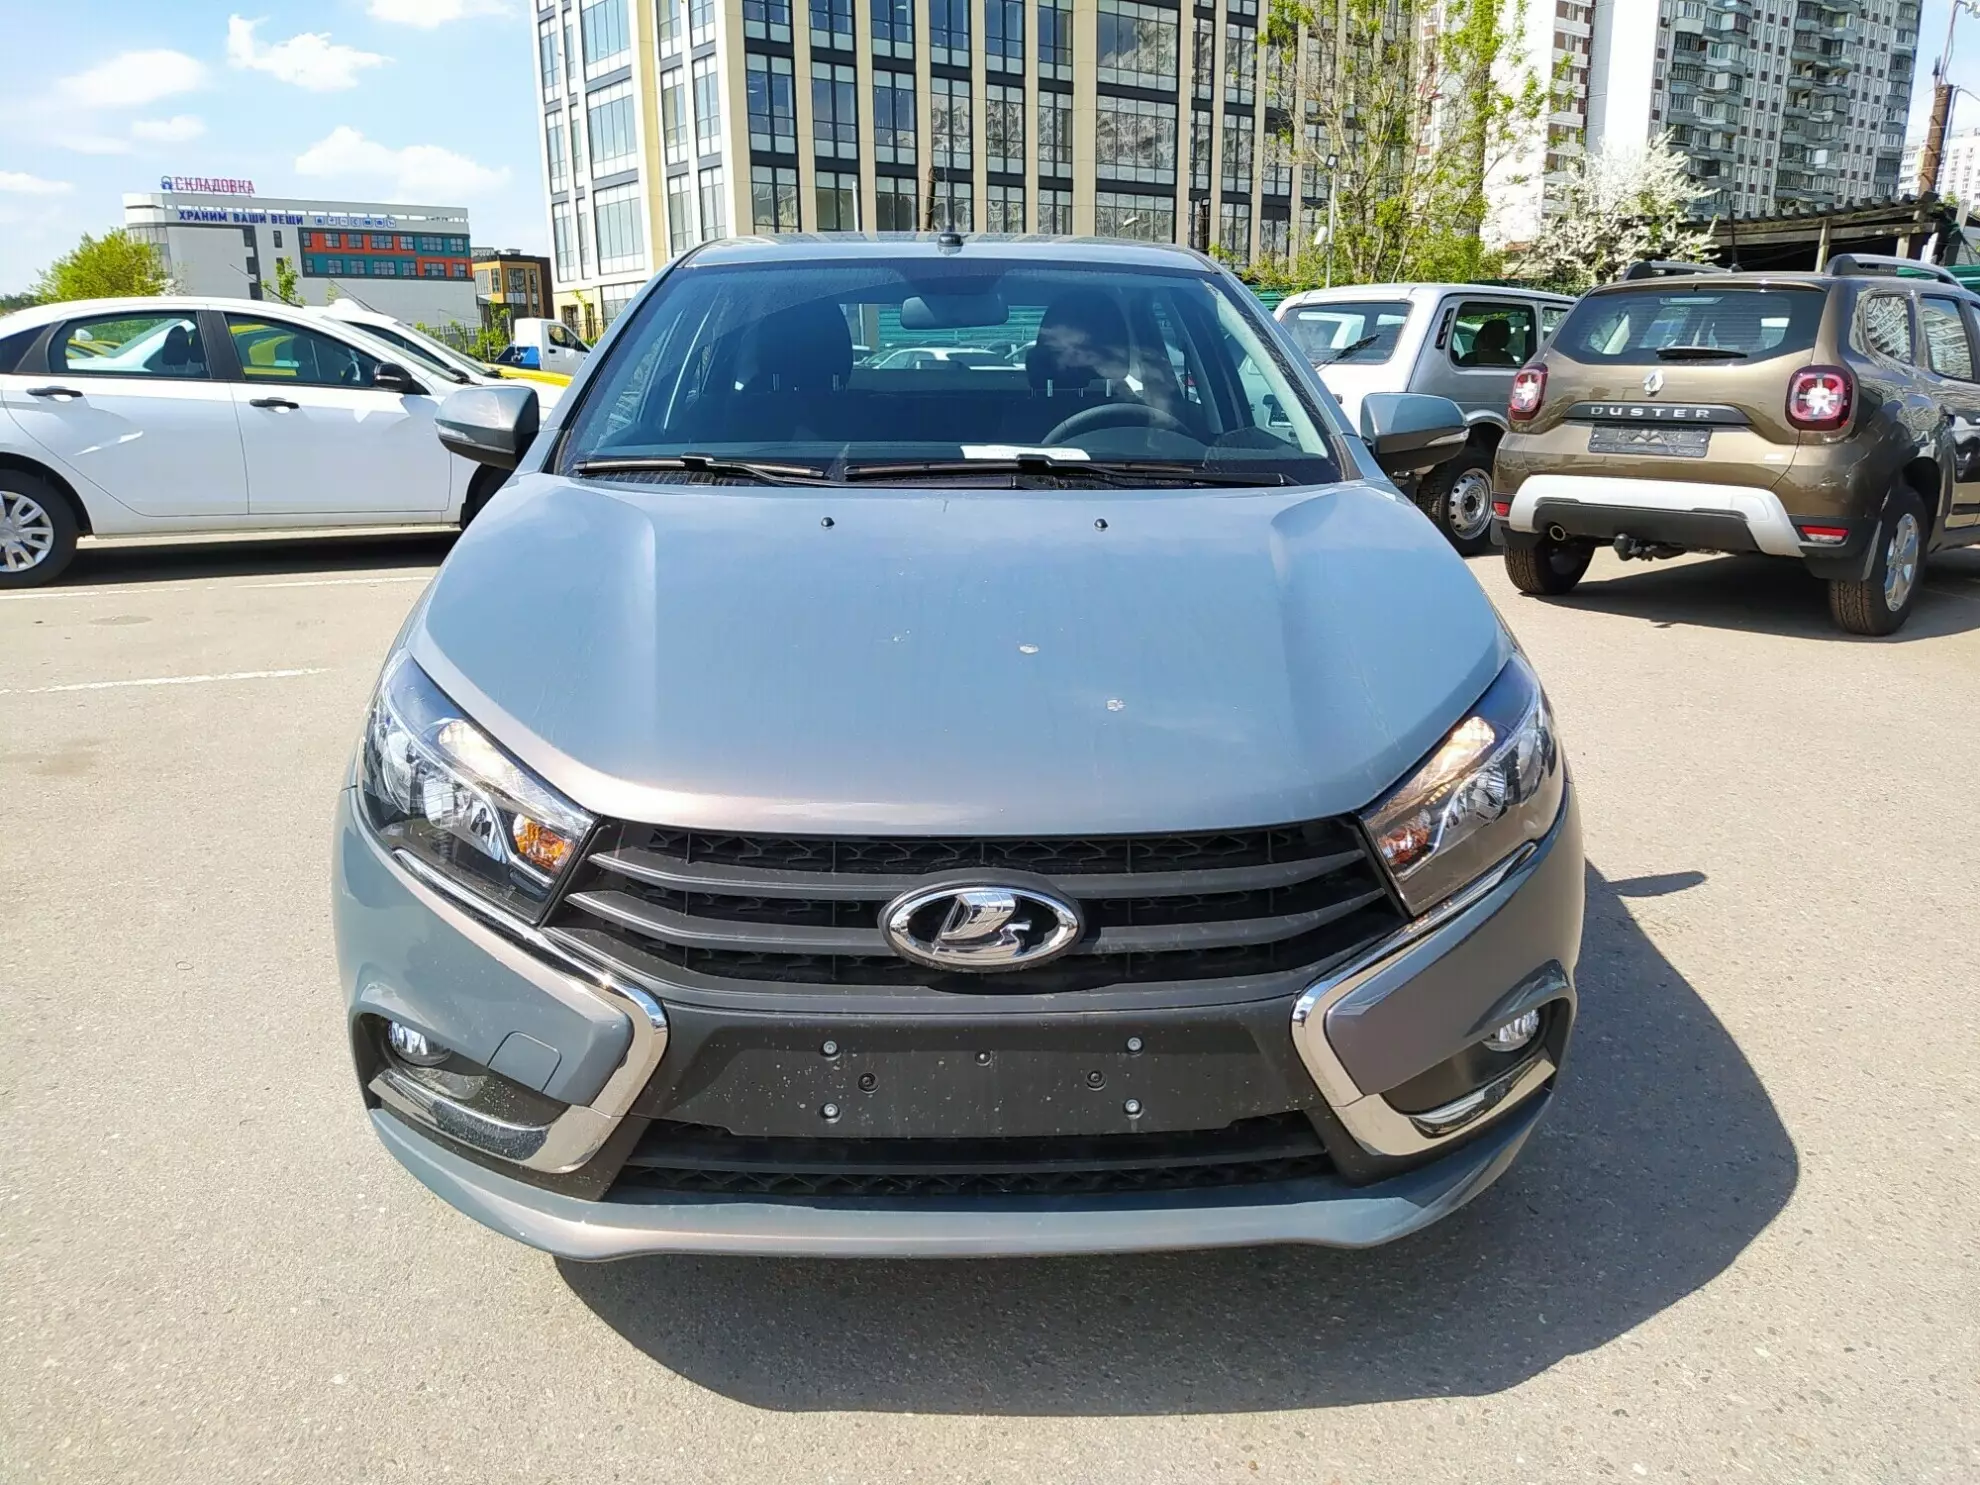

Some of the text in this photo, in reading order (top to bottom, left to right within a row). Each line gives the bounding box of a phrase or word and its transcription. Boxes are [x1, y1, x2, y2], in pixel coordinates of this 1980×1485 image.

[174, 176, 256, 194] СКЛАДОВКА
[179, 210, 304, 225] ХРАНИМ ВАШИ ВЕЩИ
[1590, 406, 1711, 419] DUSTER
